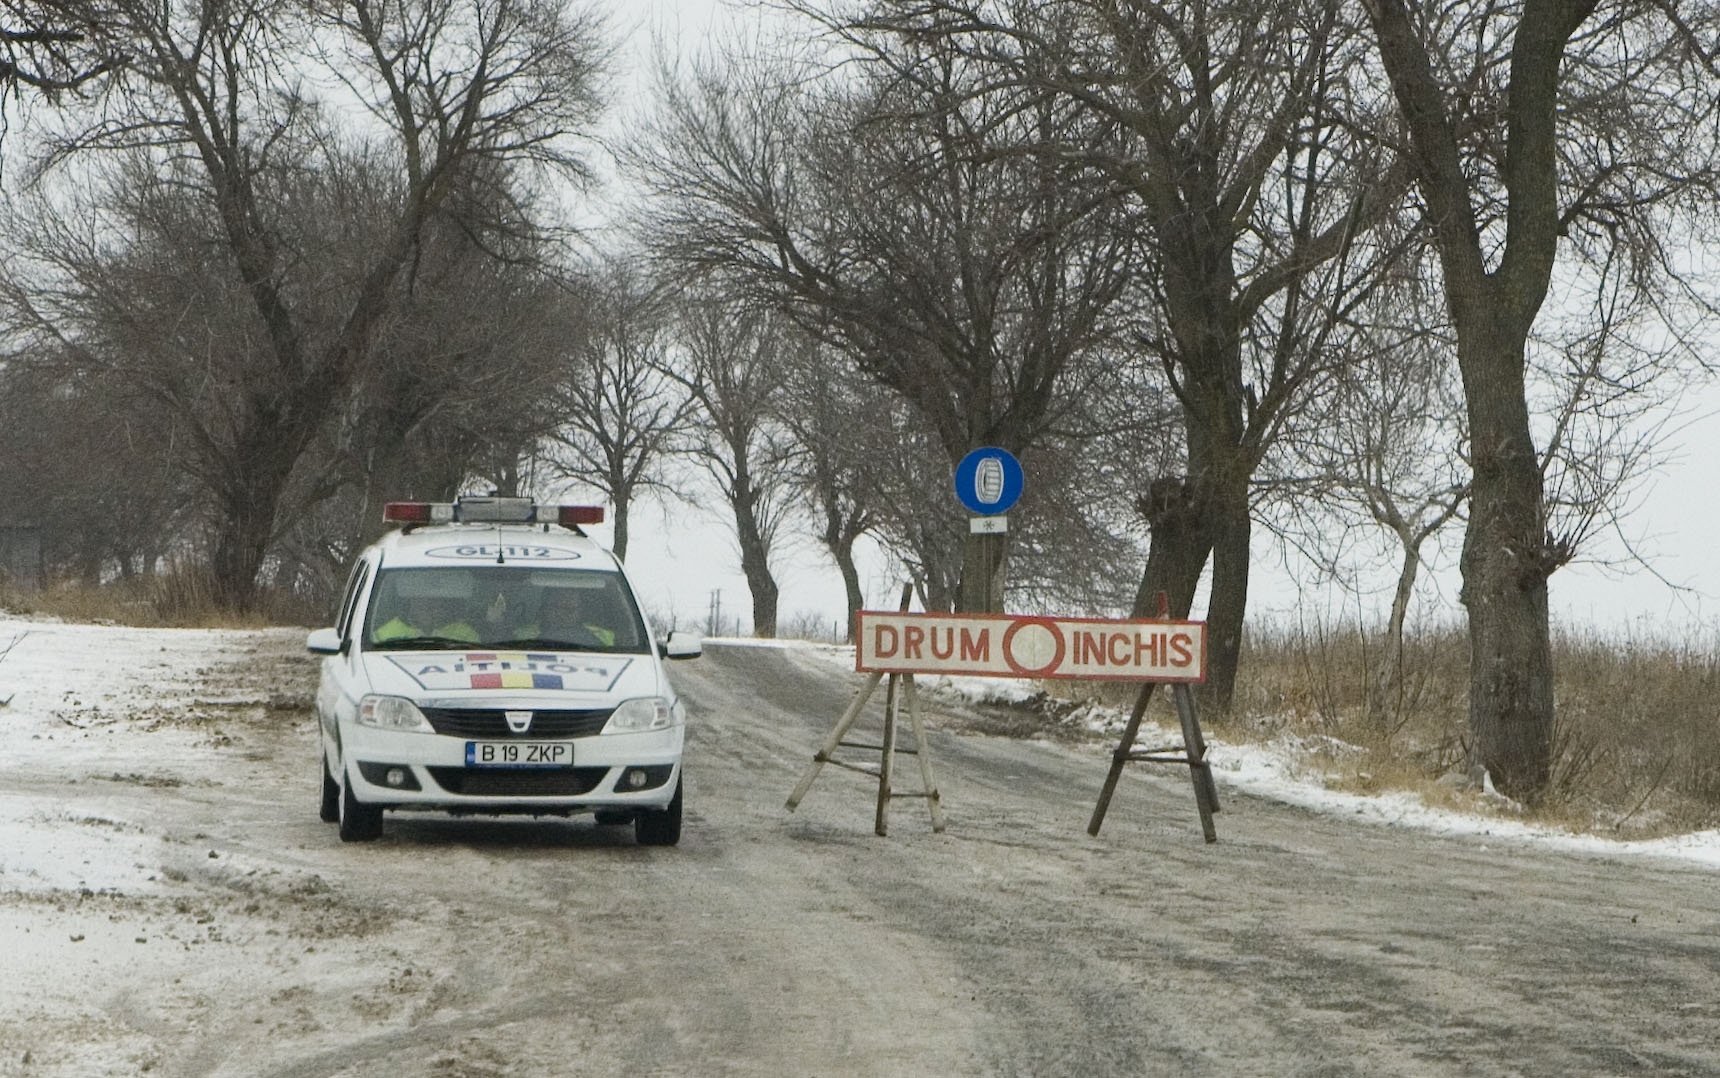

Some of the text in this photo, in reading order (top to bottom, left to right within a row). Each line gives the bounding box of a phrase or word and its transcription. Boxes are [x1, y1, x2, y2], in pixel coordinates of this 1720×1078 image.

[875, 624, 1193, 667] DRUM INCHIS
[482, 745, 565, 762] B 19 ZKP
